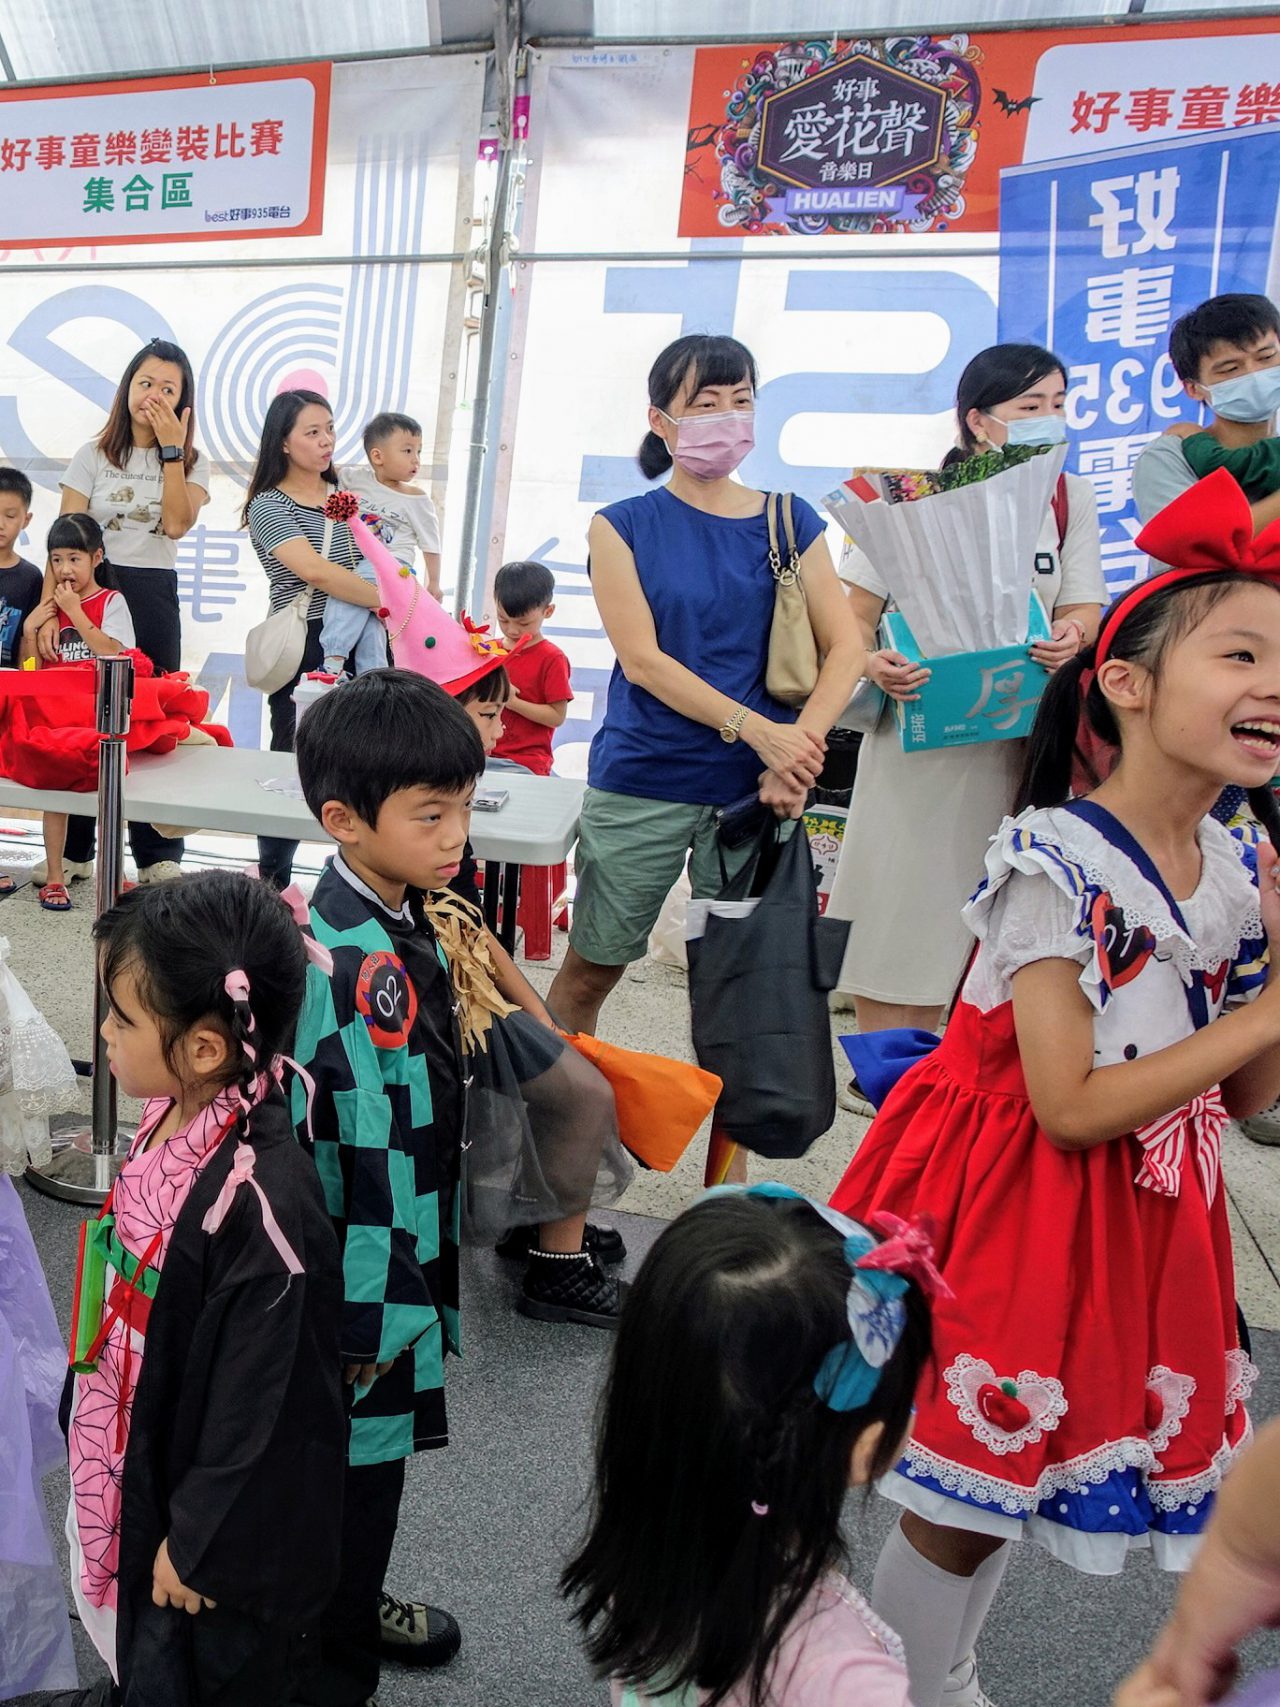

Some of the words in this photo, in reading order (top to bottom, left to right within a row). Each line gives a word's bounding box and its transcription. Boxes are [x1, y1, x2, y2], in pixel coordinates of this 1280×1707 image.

[831, 76, 881, 102] 好事
[0, 119, 284, 172] 好事童樂變裝比賽
[778, 100, 930, 163] 愛花聲
[819, 161, 874, 182] 音樂日
[83, 172, 193, 213] 集合區
[793, 190, 897, 210] HUALIEN
[104, 470, 120, 479] The
[120, 472, 145, 480] cutest
[376, 975, 402, 1017] 02
